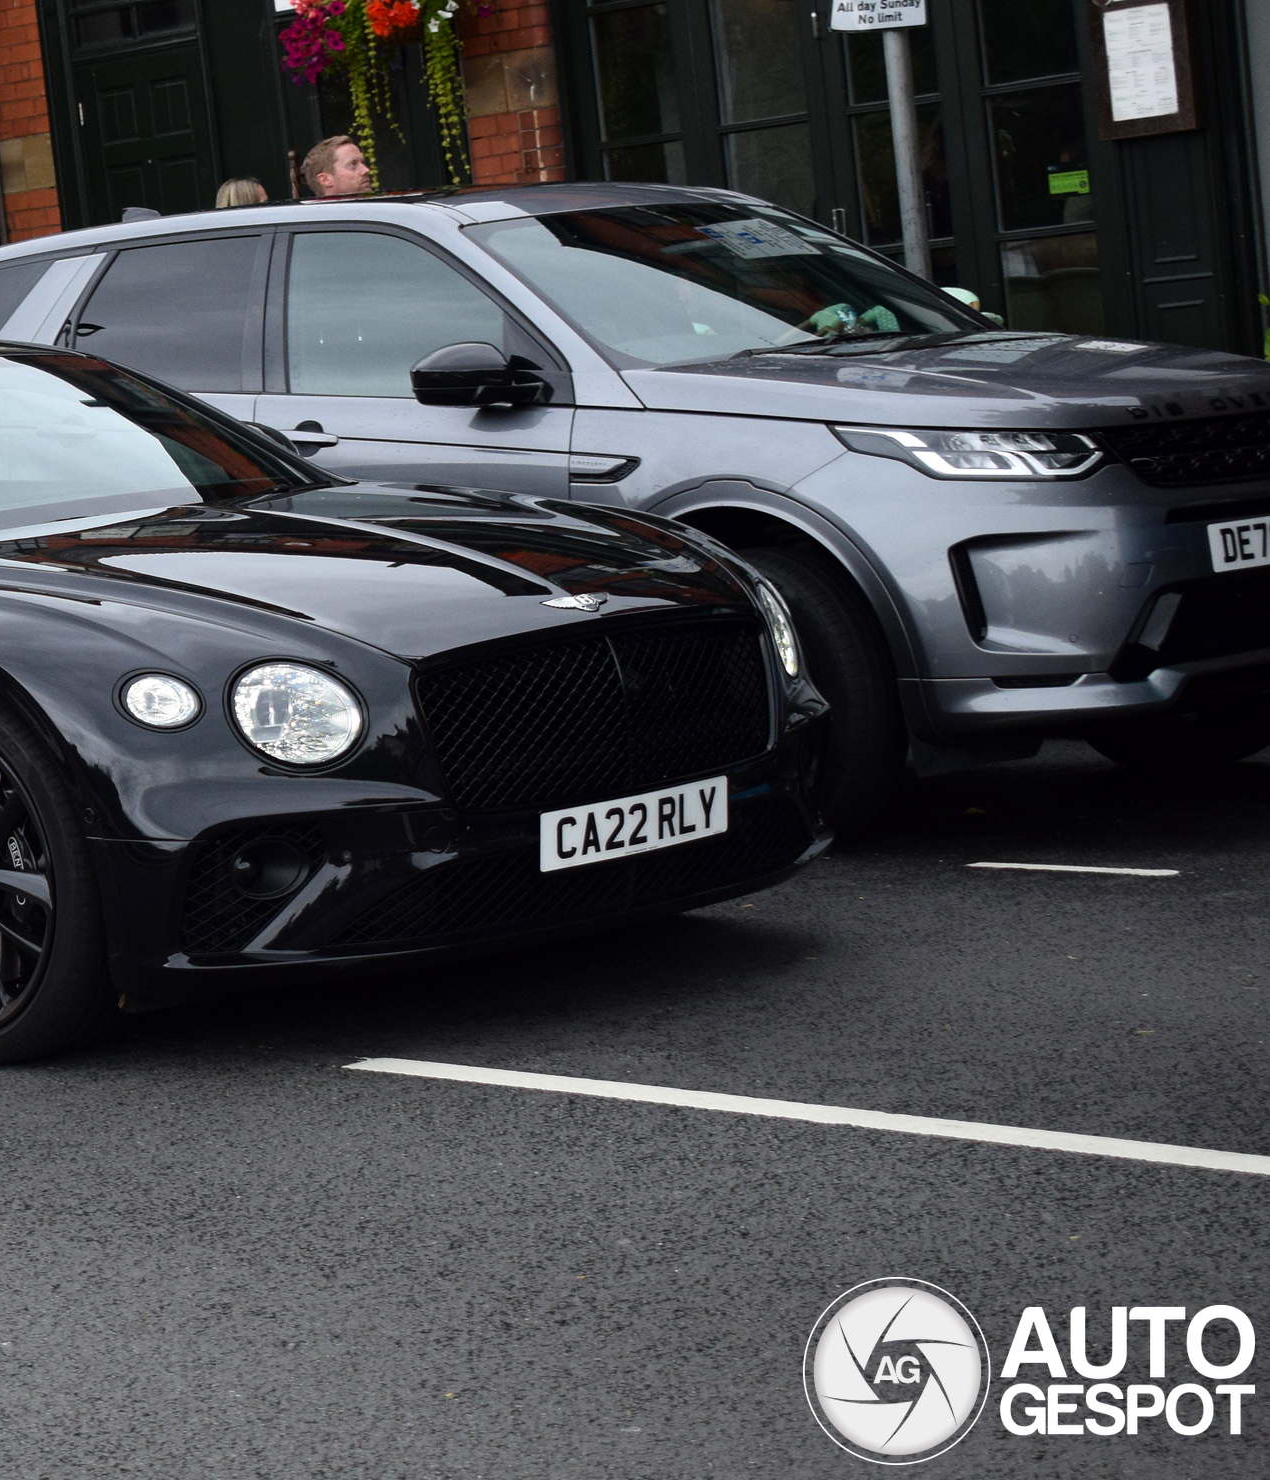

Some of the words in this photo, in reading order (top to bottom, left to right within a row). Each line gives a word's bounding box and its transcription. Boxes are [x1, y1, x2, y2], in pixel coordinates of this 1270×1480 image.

[837, 3, 853, 12] All
[857, 1, 876, 12] day
[880, 0, 920, 10] Sunday
[858, 14, 874, 24] No
[877, 11, 902, 23] limit
[1126, 391, 1270, 419] DISOVE
[1219, 522, 1270, 563] DE7
[556, 802, 648, 859] CA22
[657, 786, 716, 840] RLY
